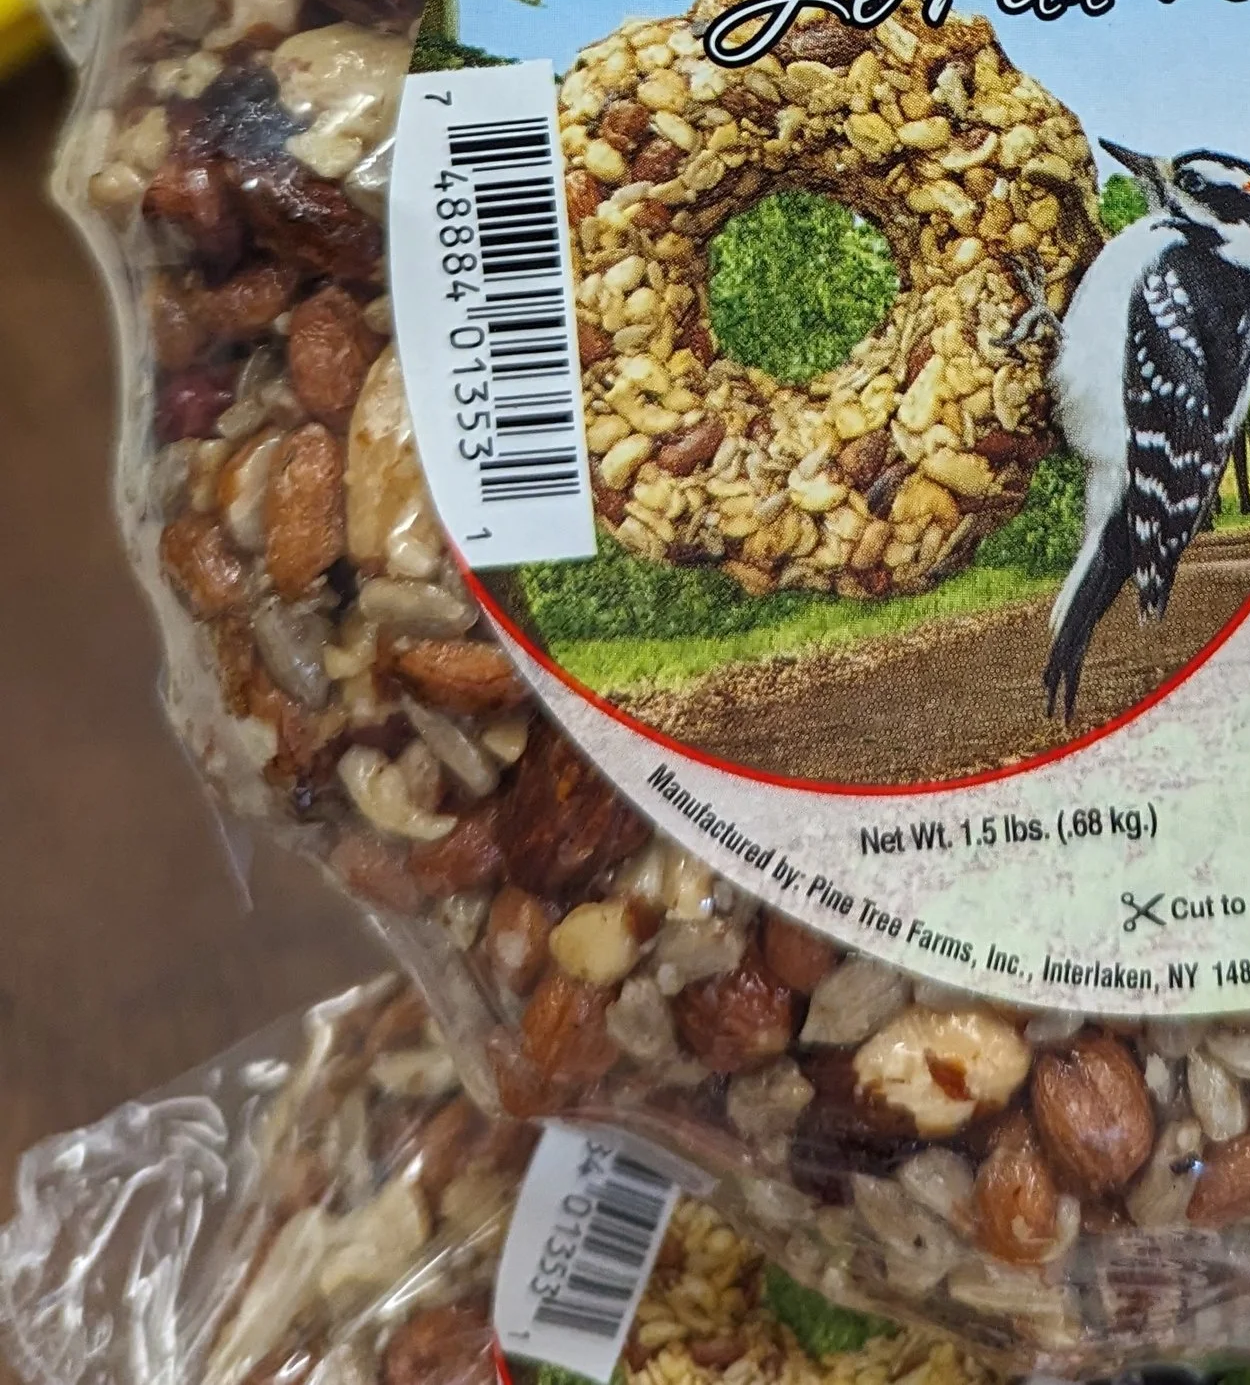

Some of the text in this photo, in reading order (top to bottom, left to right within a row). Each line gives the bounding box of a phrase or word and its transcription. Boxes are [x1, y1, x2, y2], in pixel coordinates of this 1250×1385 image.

[424, 90, 494, 541] 7 48884 01353 1
[646, 761, 774, 872] Manufactured
[771, 854, 804, 891] by:
[807, 873, 854, 914] Pine
[858, 897, 902, 937] Tree
[906, 919, 978, 971] Farms,
[986, 943, 1034, 984] Inc.,
[1042, 955, 1160, 993] Interlaken,
[1168, 962, 1200, 990] NY
[859, 802, 1159, 857] Net Wt. 1.5 lbs. (.68 kg.)
[1171, 895, 1215, 921] Cut
[1220, 893, 1246, 915] to
